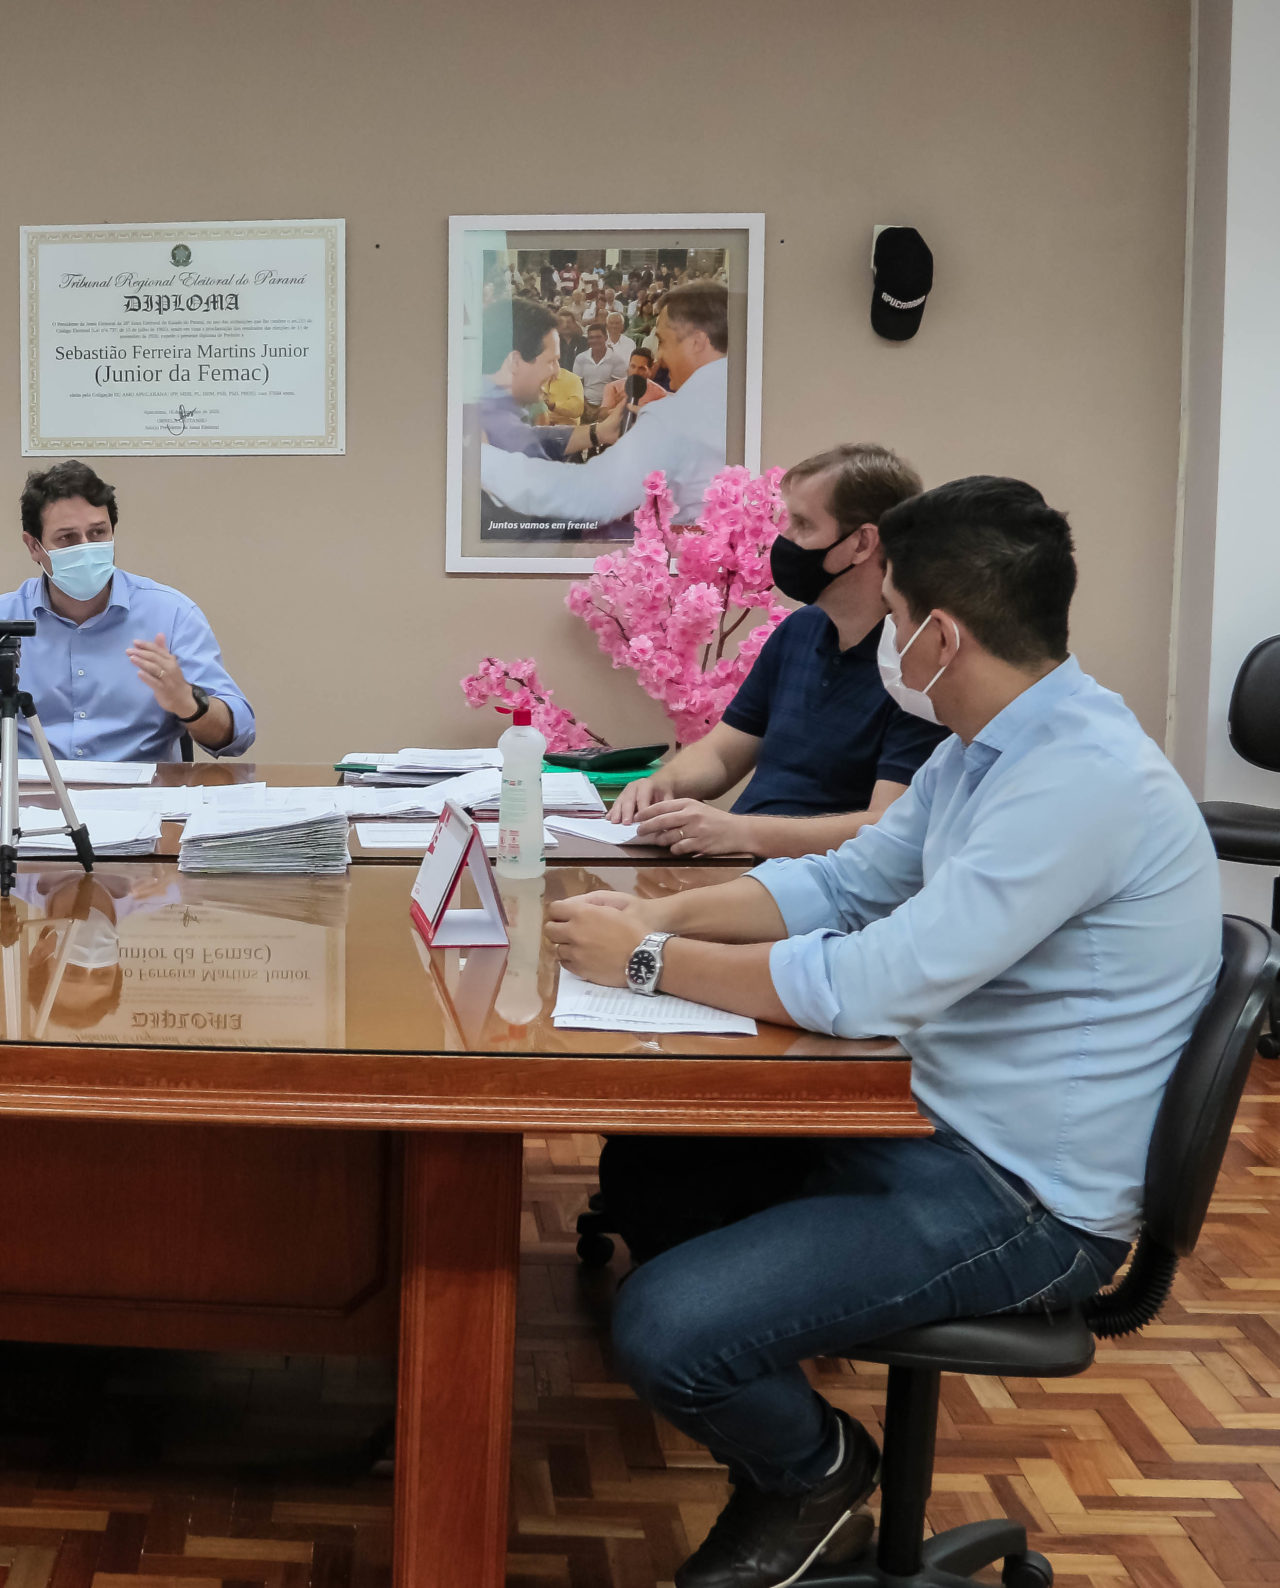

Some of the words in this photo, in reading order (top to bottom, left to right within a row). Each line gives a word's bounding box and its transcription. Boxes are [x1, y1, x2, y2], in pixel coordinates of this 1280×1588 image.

[58, 273, 116, 289] Tribunal
[115, 272, 175, 293] Regional
[178, 271, 235, 288] Eleitoral
[235, 273, 250, 286] do
[254, 269, 307, 285] Paraná
[123, 293, 240, 315] DIPLOMA
[55, 345, 127, 361] Sebastião
[132, 345, 192, 360] Ferreira
[197, 344, 256, 359] Martins
[261, 343, 310, 358] Junior
[95, 364, 163, 387] (Junior
[168, 363, 191, 382] da
[198, 362, 270, 386] Femac)
[488, 521, 519, 531] Juntos
[520, 522, 550, 530] vamos
[551, 522, 566, 530] em
[566, 520, 599, 530] frente!
